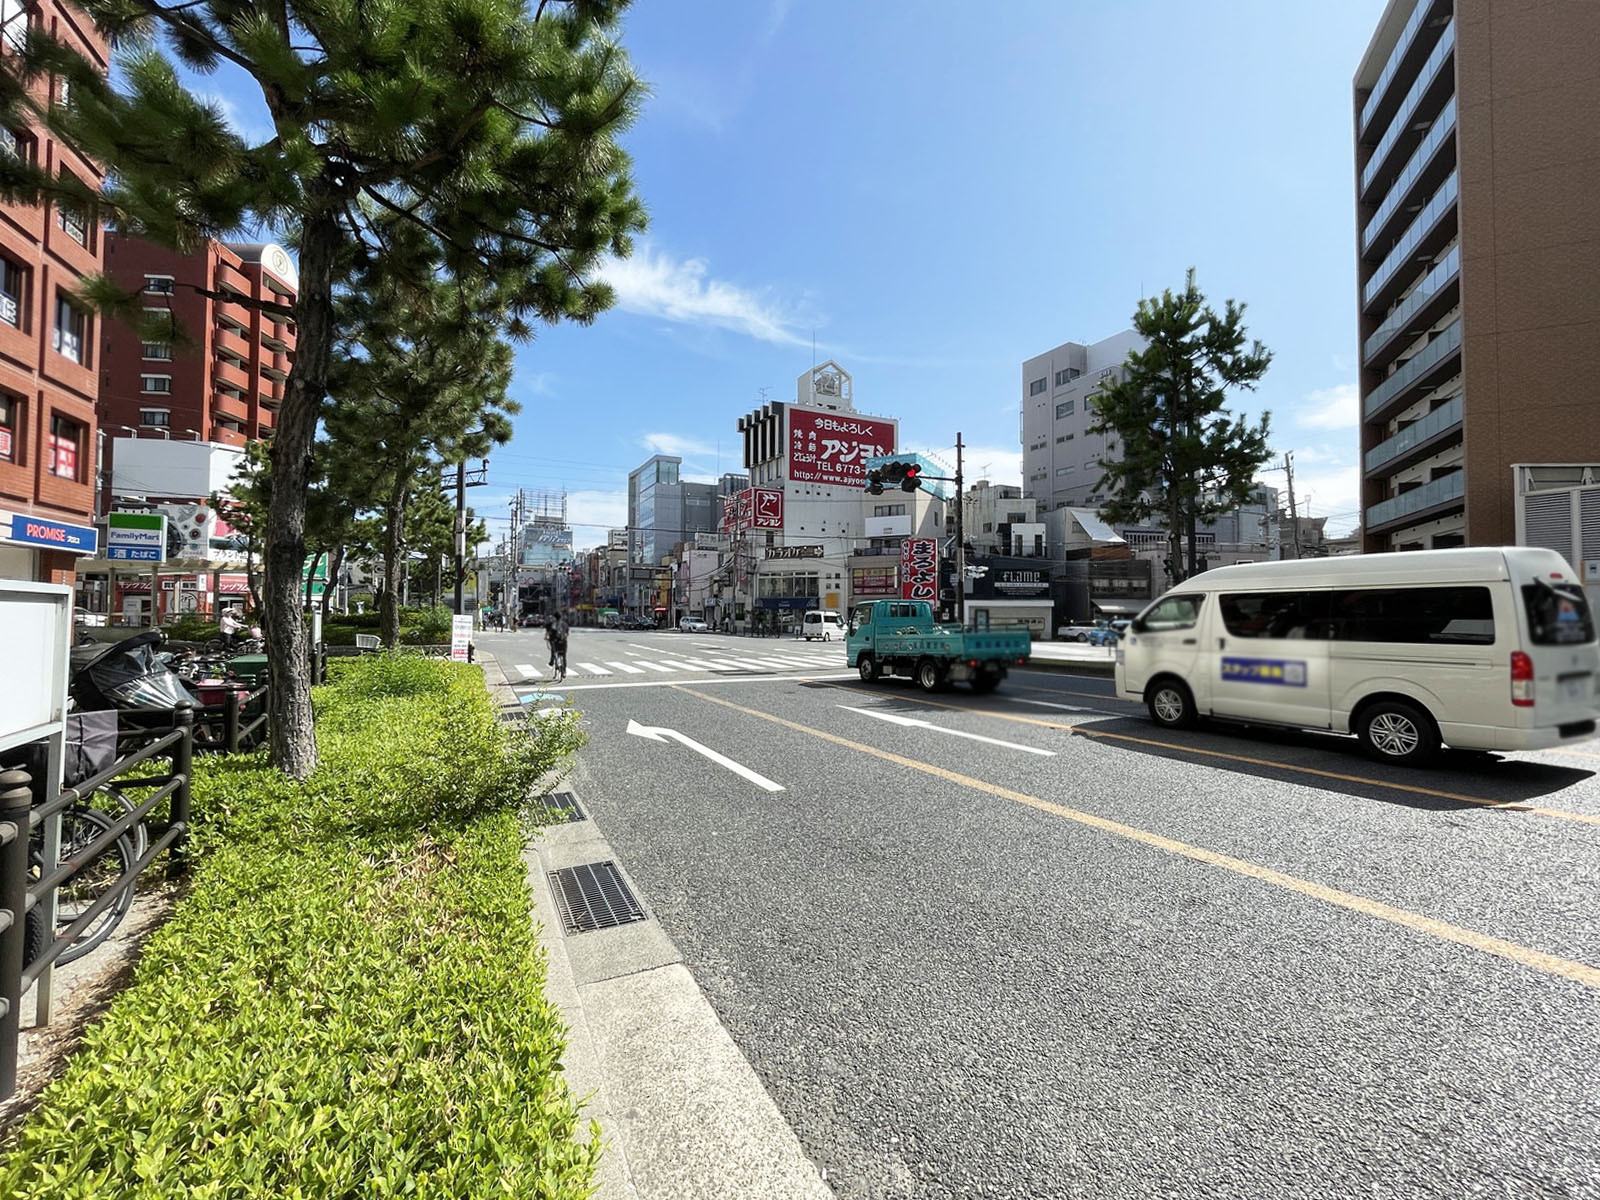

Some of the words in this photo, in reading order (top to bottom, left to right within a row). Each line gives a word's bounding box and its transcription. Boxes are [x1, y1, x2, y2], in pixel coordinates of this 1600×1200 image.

[814, 418, 873, 436] 今日もよろしく
[816, 461, 834, 472] TEL
[26, 523, 66, 542] PROMISE
[110, 531, 160, 542] FamilyMart
[114, 549, 126, 559] 酒
[130, 550, 157, 560] たばこ
[766, 546, 801, 558] カラオケ
[1222, 663, 1284, 678] スタッフ
